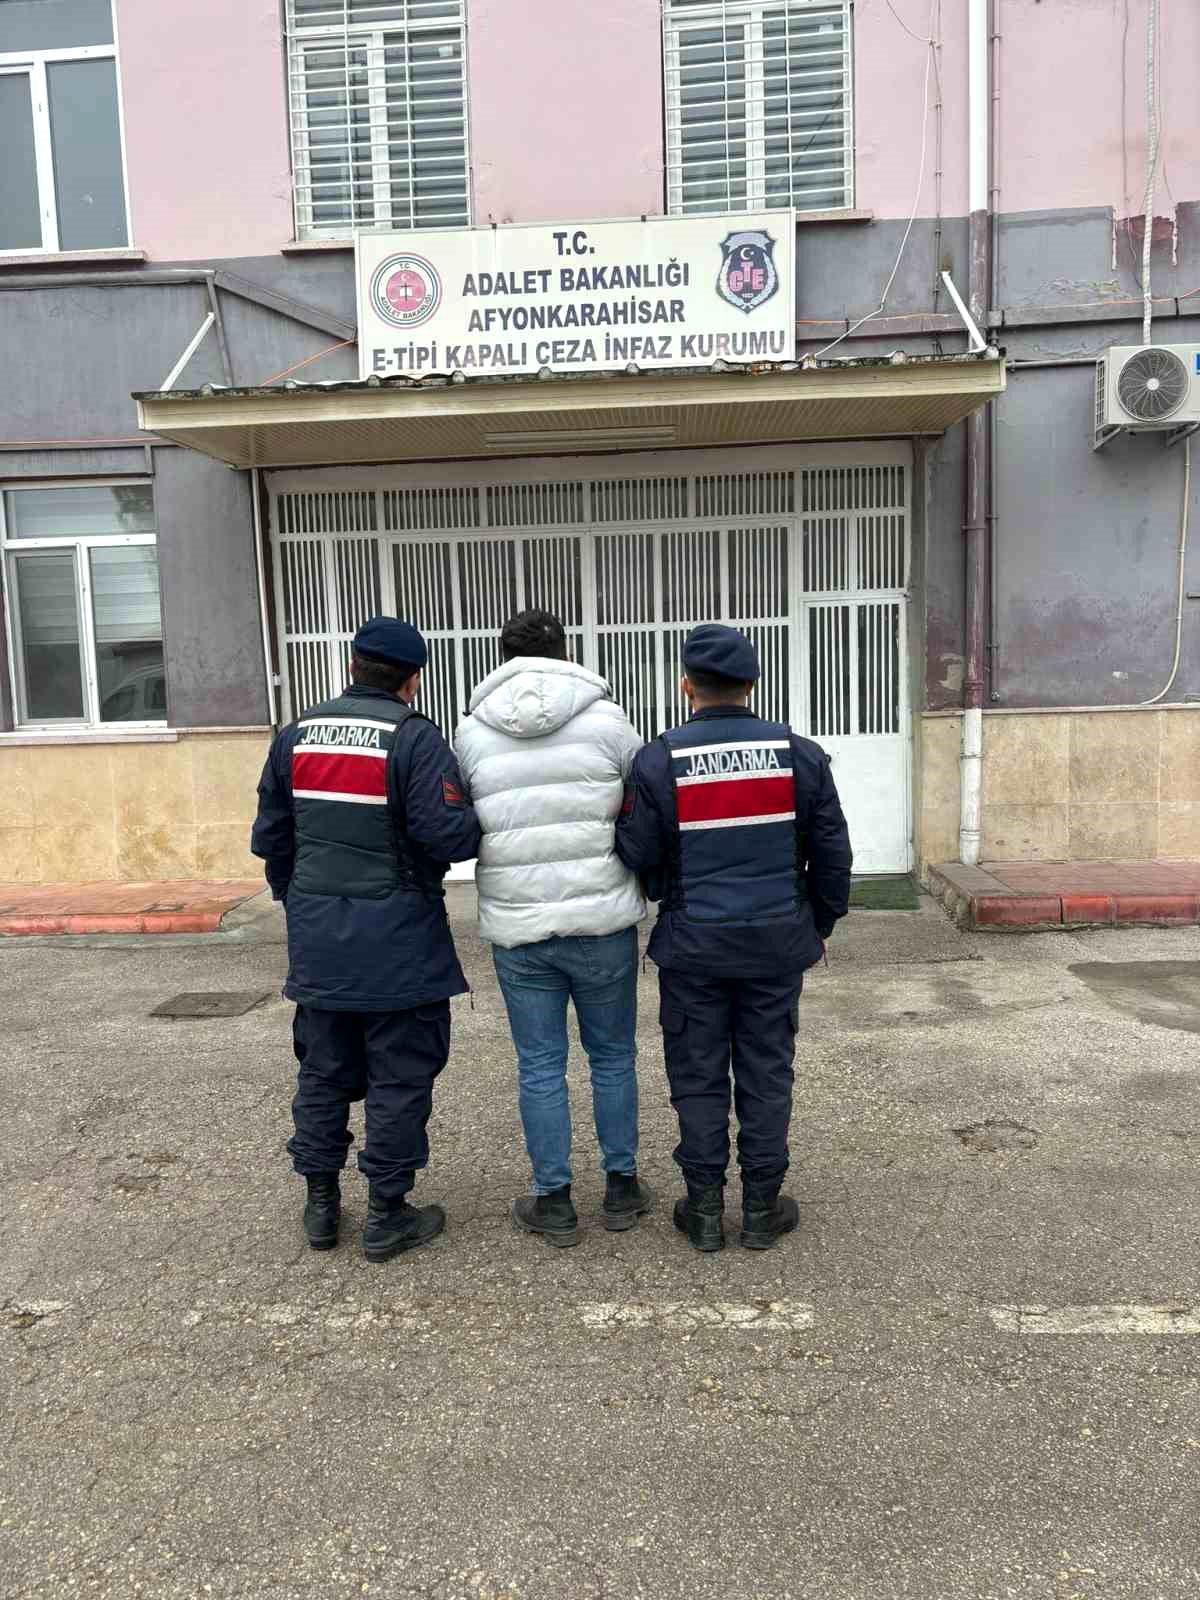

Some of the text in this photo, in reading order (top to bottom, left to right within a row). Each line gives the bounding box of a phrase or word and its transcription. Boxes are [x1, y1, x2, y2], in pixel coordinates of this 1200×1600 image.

[553, 231, 595, 256] T.C.
[462, 257, 690, 297] ADALET BAKANLIĞI
[468, 295, 685, 332] AFYONKARAHİSAR
[373, 330, 785, 371] E-TİPİ KAPALI CEZA İNFAZ KURUMU
[301, 725, 380, 748] JANDARMA
[686, 749, 780, 776] JANDARMA
